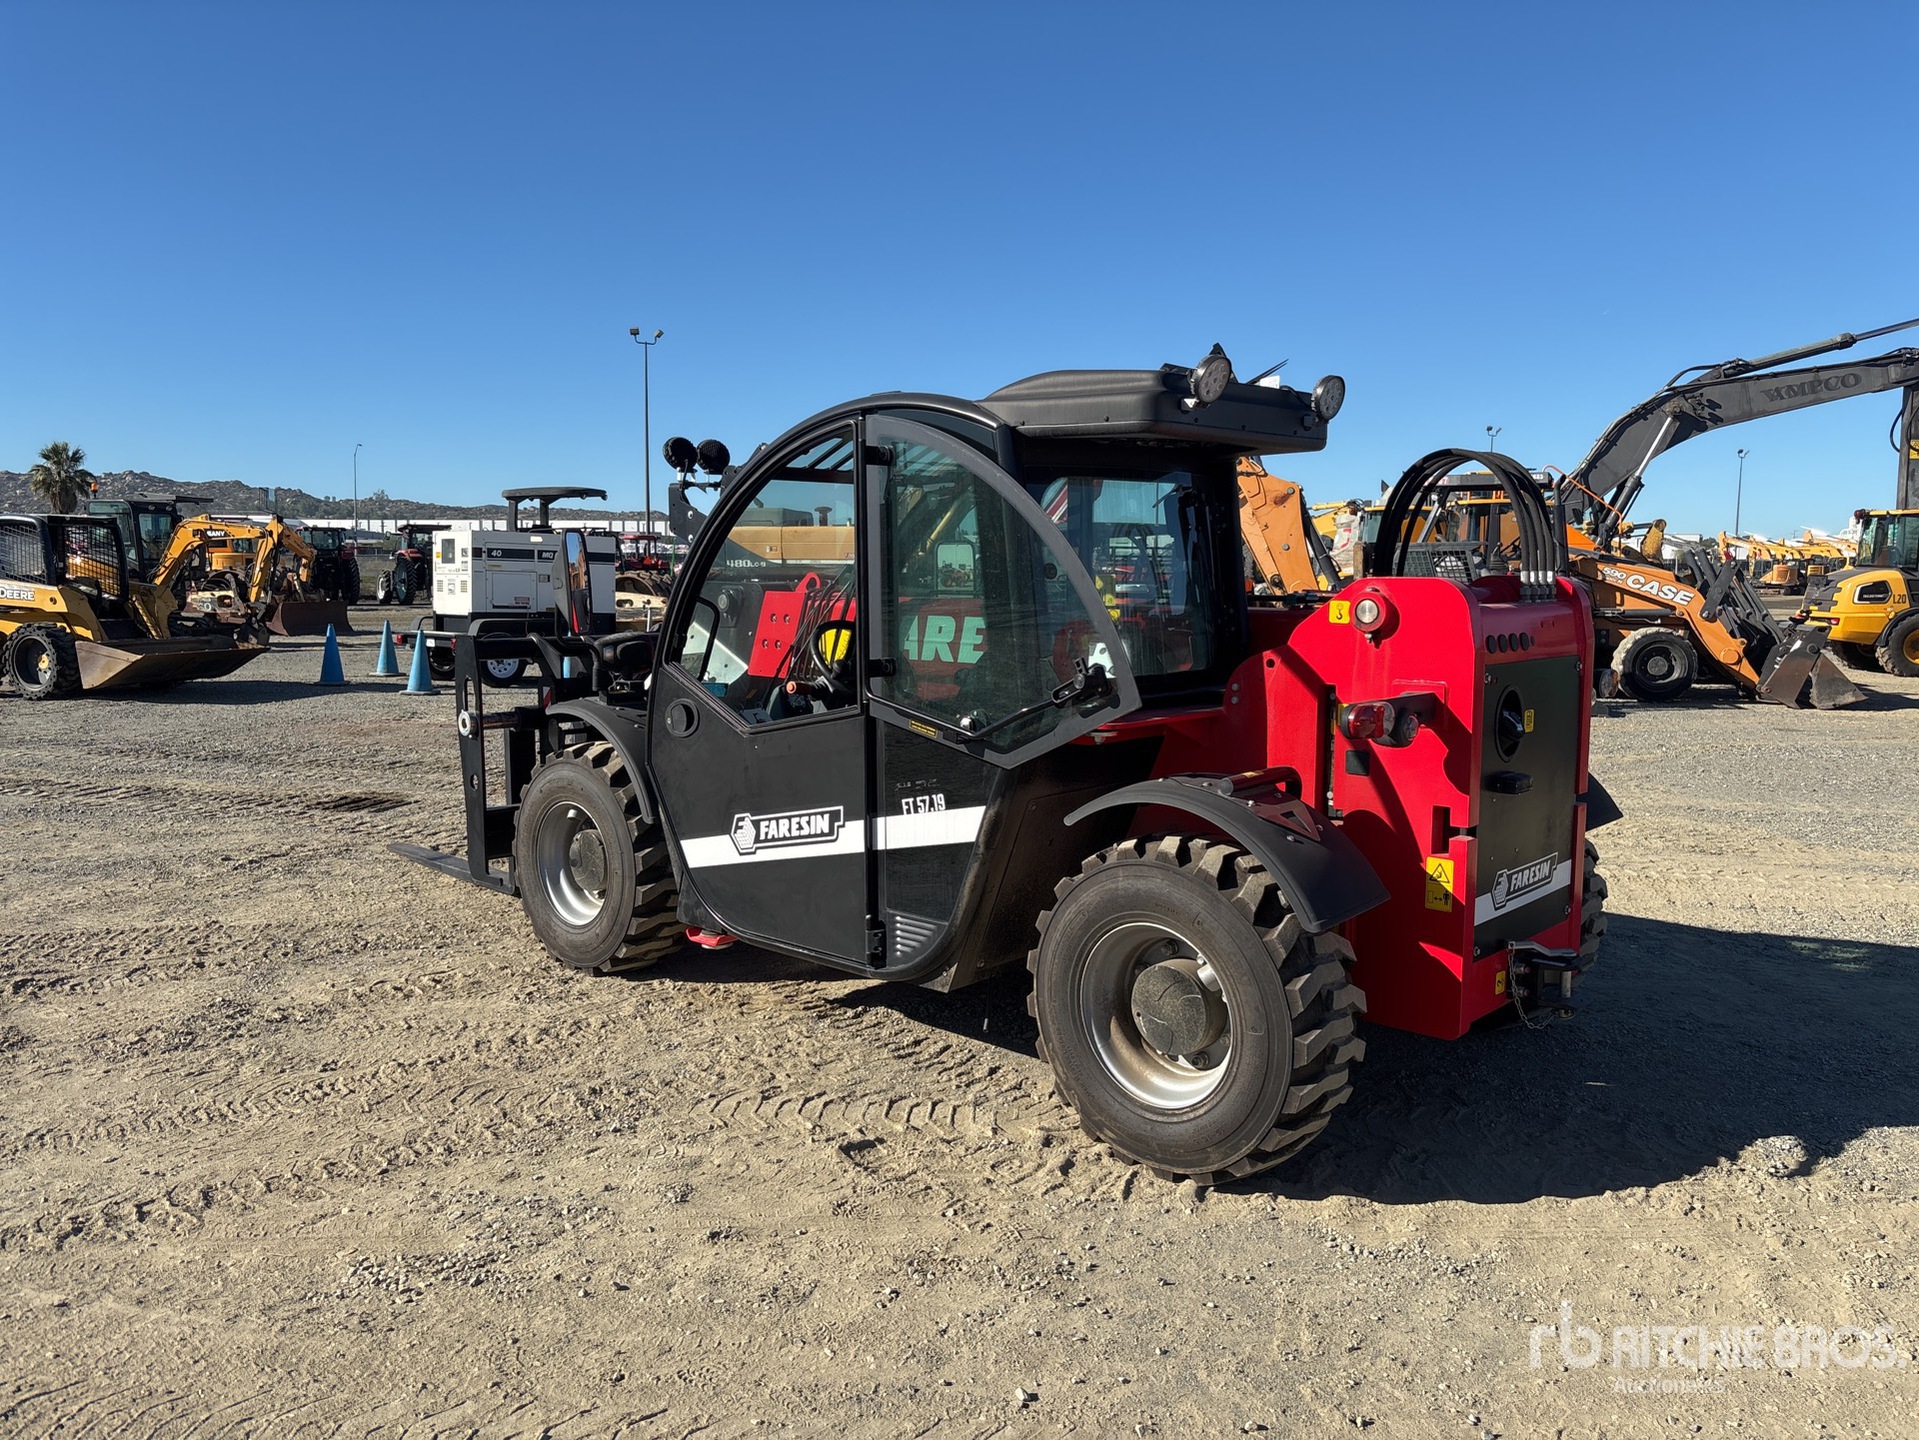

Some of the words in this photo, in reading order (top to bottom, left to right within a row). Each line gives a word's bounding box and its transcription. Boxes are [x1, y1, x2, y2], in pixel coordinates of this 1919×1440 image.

[491, 549, 502, 557] 40
[1602, 566, 1627, 580] 590
[0, 586, 35, 601] DEERE
[1626, 574, 1695, 606] CASE
[1893, 594, 1907, 604] L20
[901, 797, 914, 815] FT
[916, 793, 946, 814] 57.19
[759, 813, 830, 841] FARESIN
[1509, 860, 1551, 892] FARESIN
